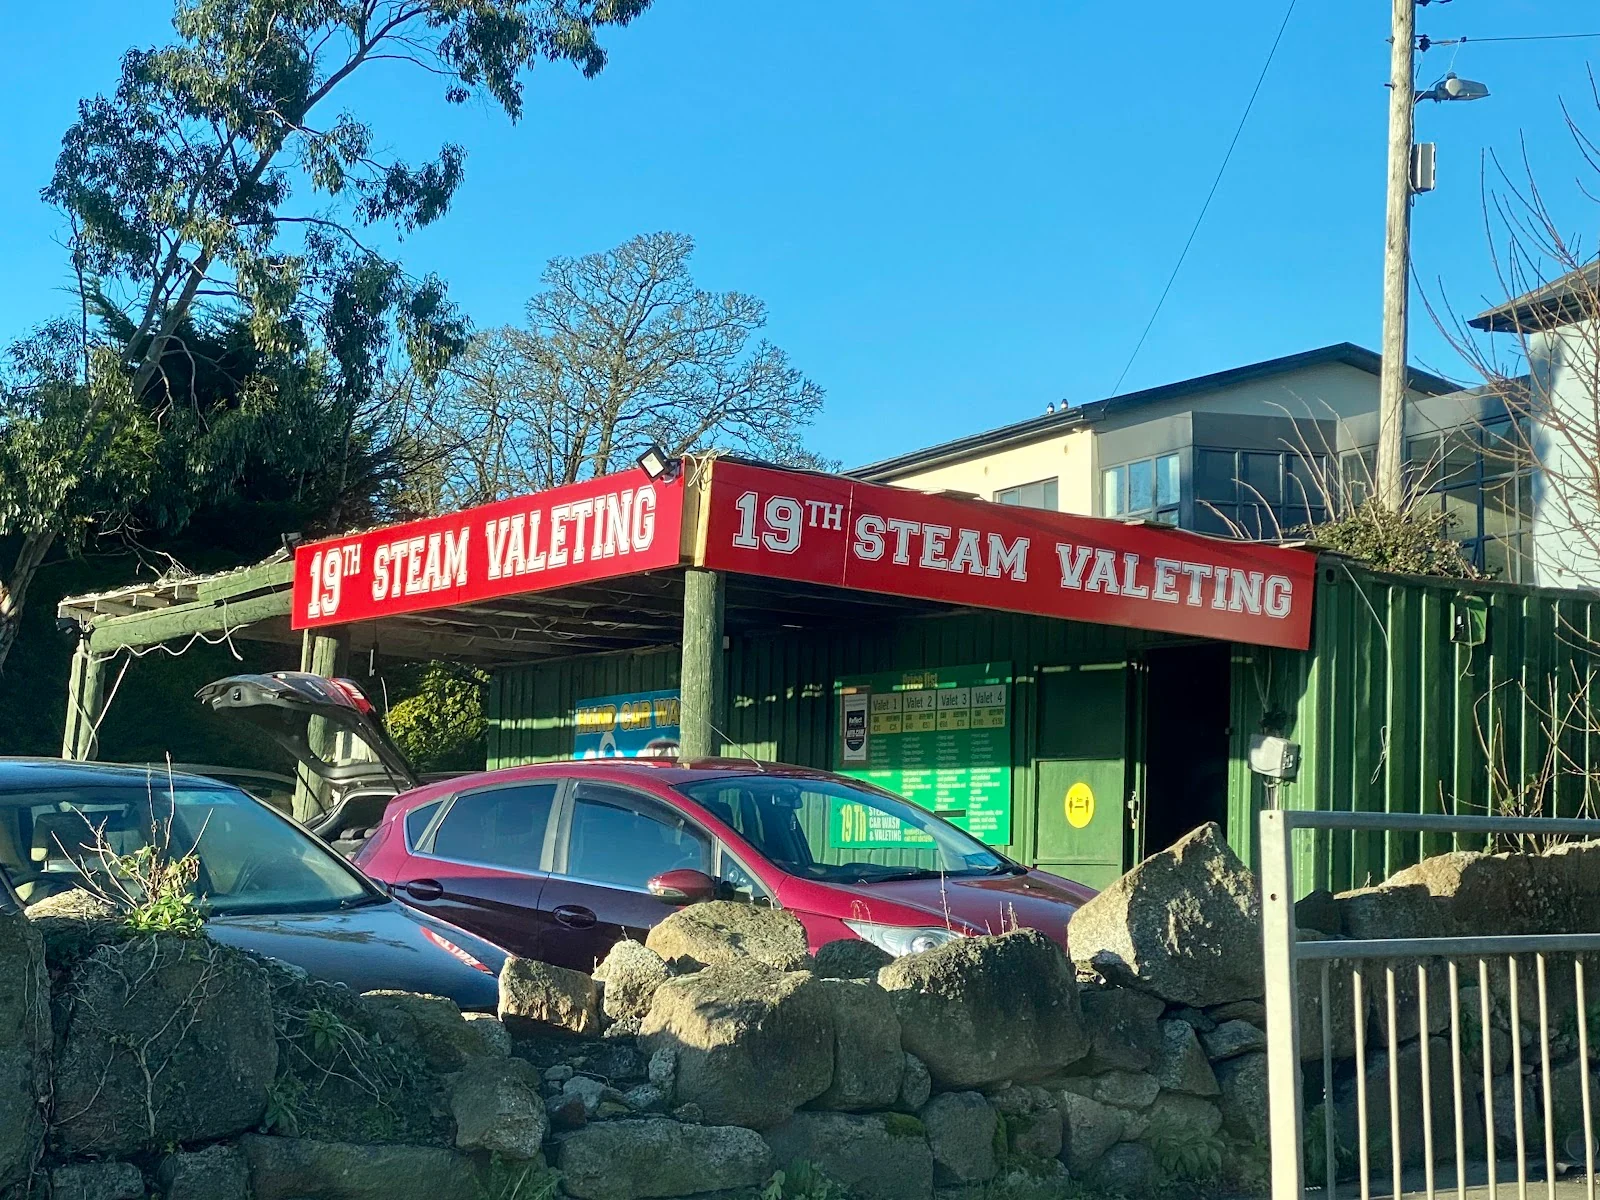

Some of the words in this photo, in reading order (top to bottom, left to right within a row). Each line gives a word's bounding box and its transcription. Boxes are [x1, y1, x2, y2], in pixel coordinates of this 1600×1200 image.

[307, 543, 361, 619] 19TH
[372, 526, 470, 601] STEAM
[485, 484, 656, 580] VALETING
[732, 490, 844, 555] 19TH
[853, 514, 1030, 582] STEAM
[1056, 543, 1293, 619] VALETING
[906, 696, 924, 709] Valet
[927, 696, 932, 708] 2
[941, 694, 958, 706] Valet
[961, 693, 967, 705] 3
[975, 692, 993, 704] Valet
[997, 691, 1003, 703] 4
[873, 698, 889, 712] Valet
[893, 698, 898, 710] 1
[577, 704, 617, 735] HAND
[620, 700, 652, 732] CAR
[869, 806, 889, 816] STE
[841, 804, 852, 842] 19
[854, 804, 867, 842] Th
[869, 817, 881, 829] CAR
[882, 816, 900, 829] WASH
[869, 831, 874, 841] &
[874, 829, 902, 841] VALETING
